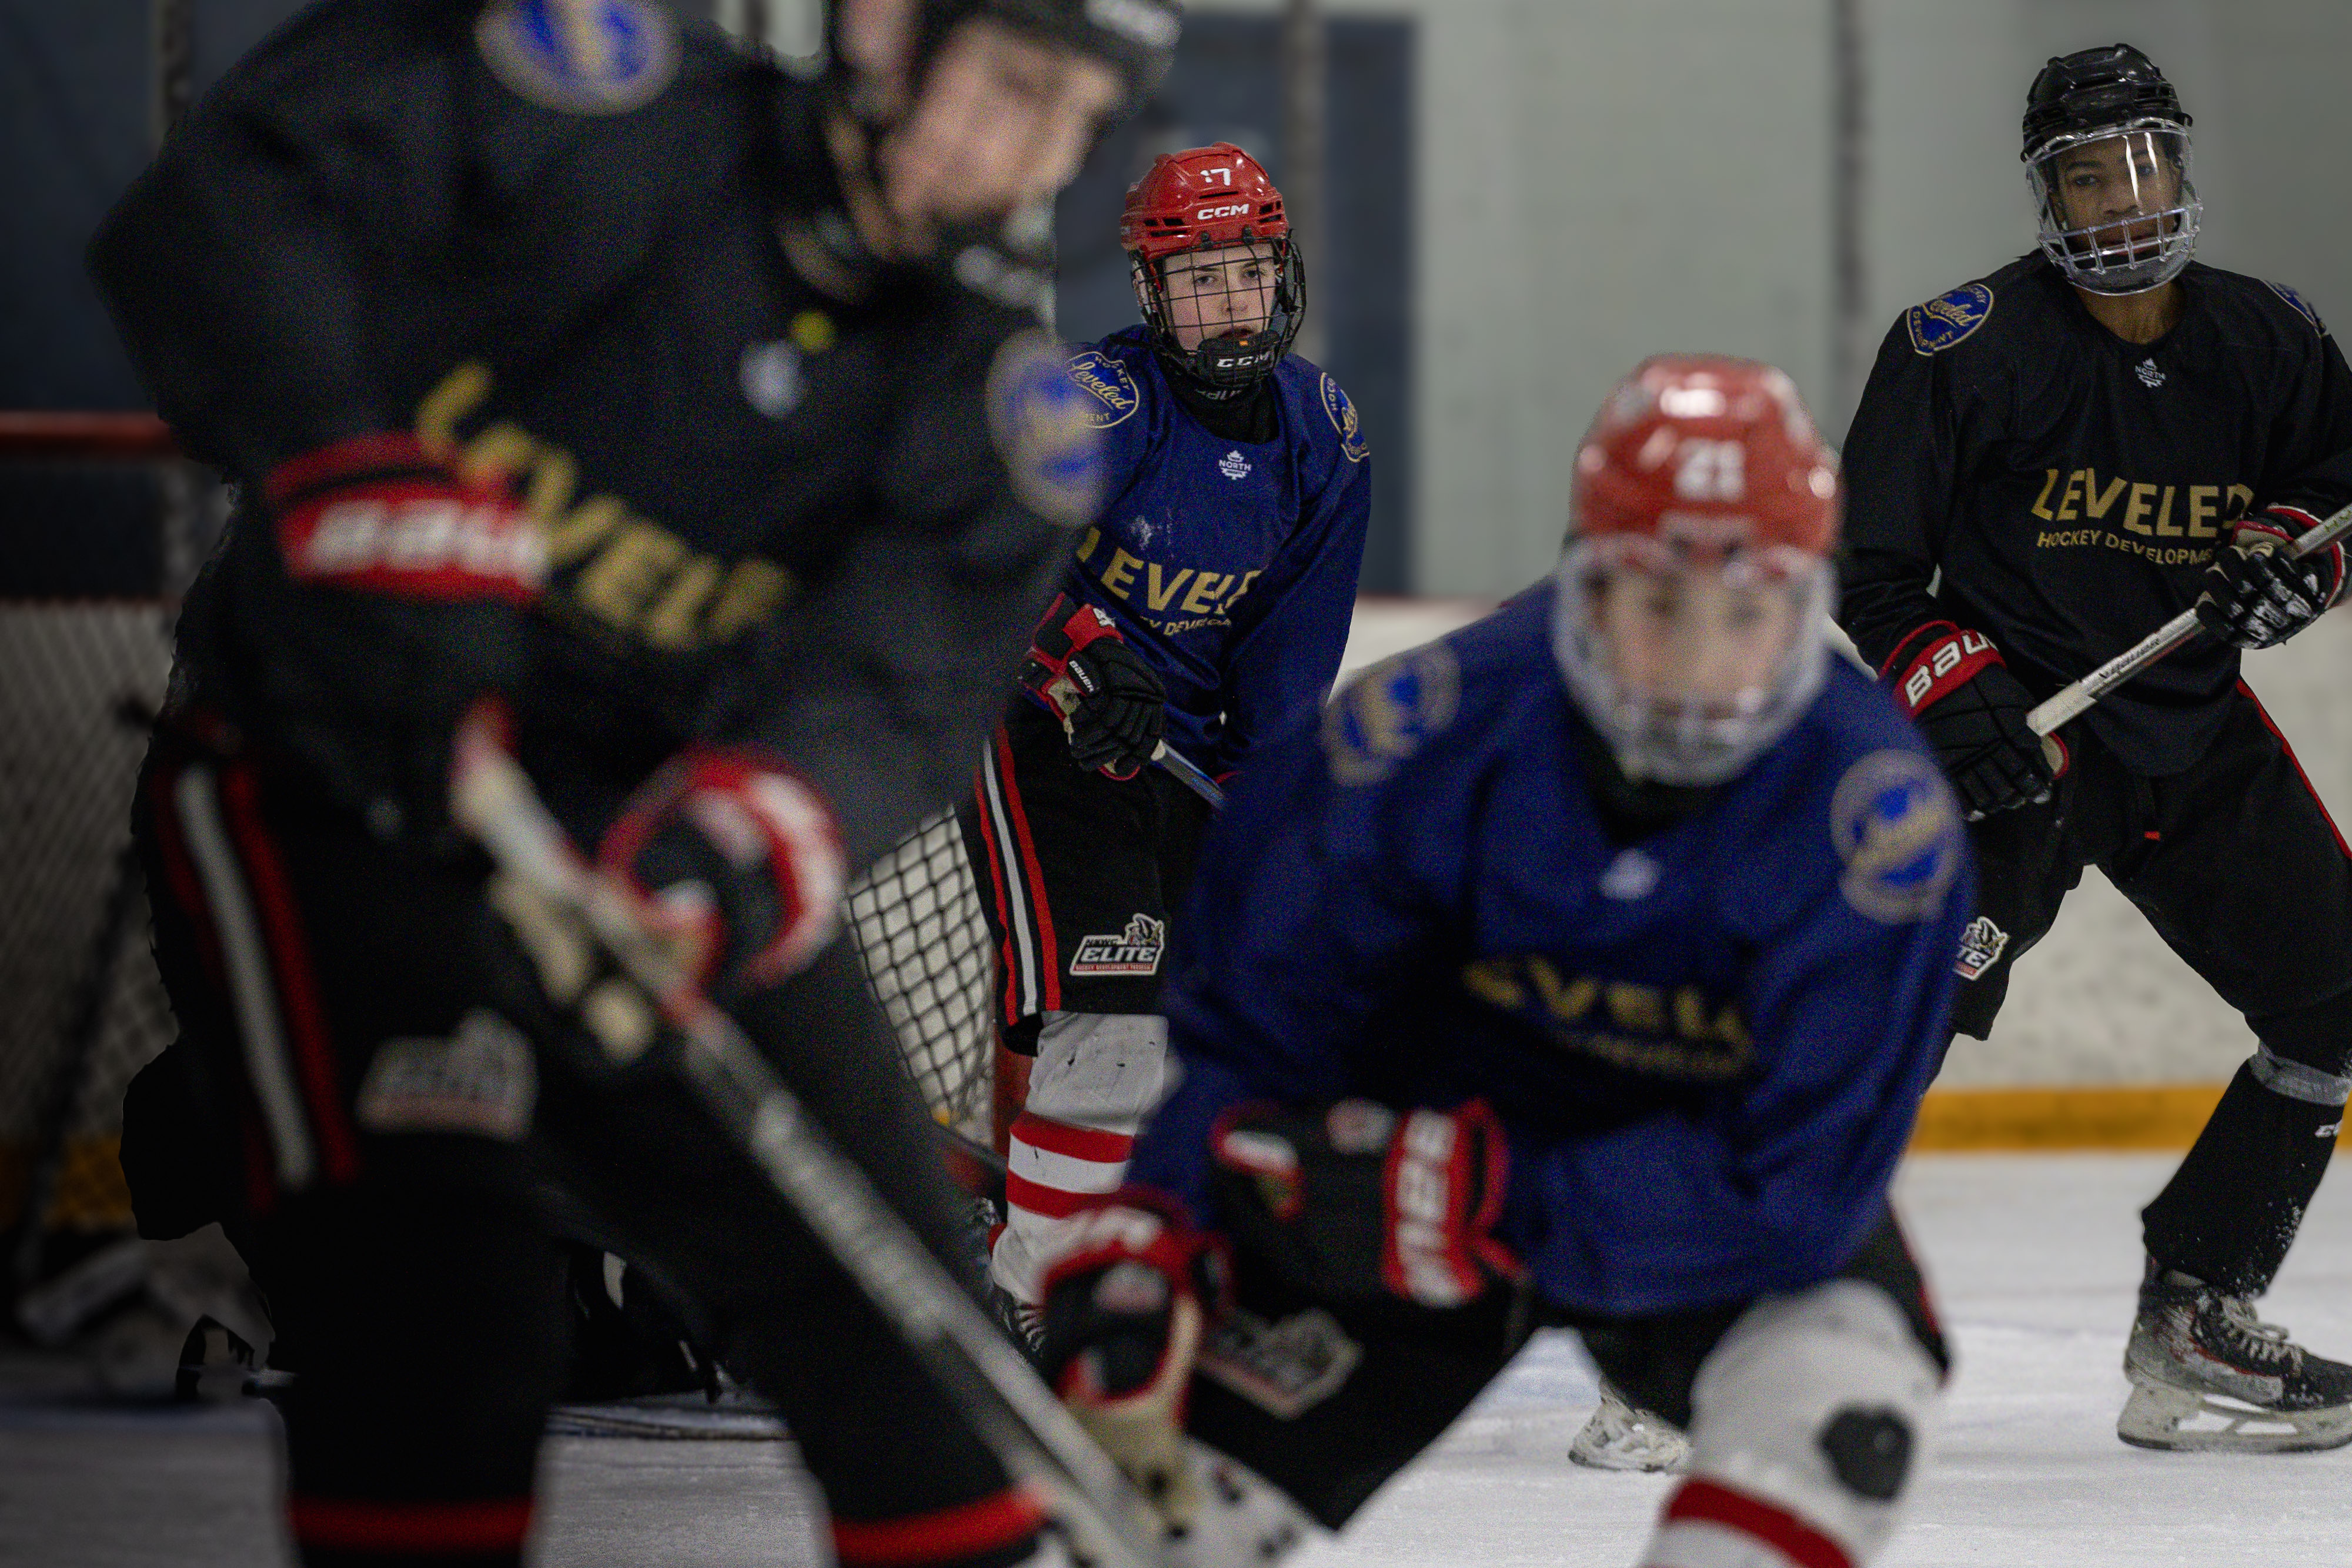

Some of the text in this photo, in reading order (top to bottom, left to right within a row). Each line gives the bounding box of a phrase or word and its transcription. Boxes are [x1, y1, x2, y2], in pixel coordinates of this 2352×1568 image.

[1197, 203, 1250, 220] CCM
[1217, 351, 1271, 368] CCM
[2134, 365, 2167, 380] NORTH
[1218, 459, 1252, 472] NORTH
[2036, 529, 2102, 549] HOCKEY
[1068, 660, 1094, 693] BAUER
[1080, 947, 1157, 963] ELITE
